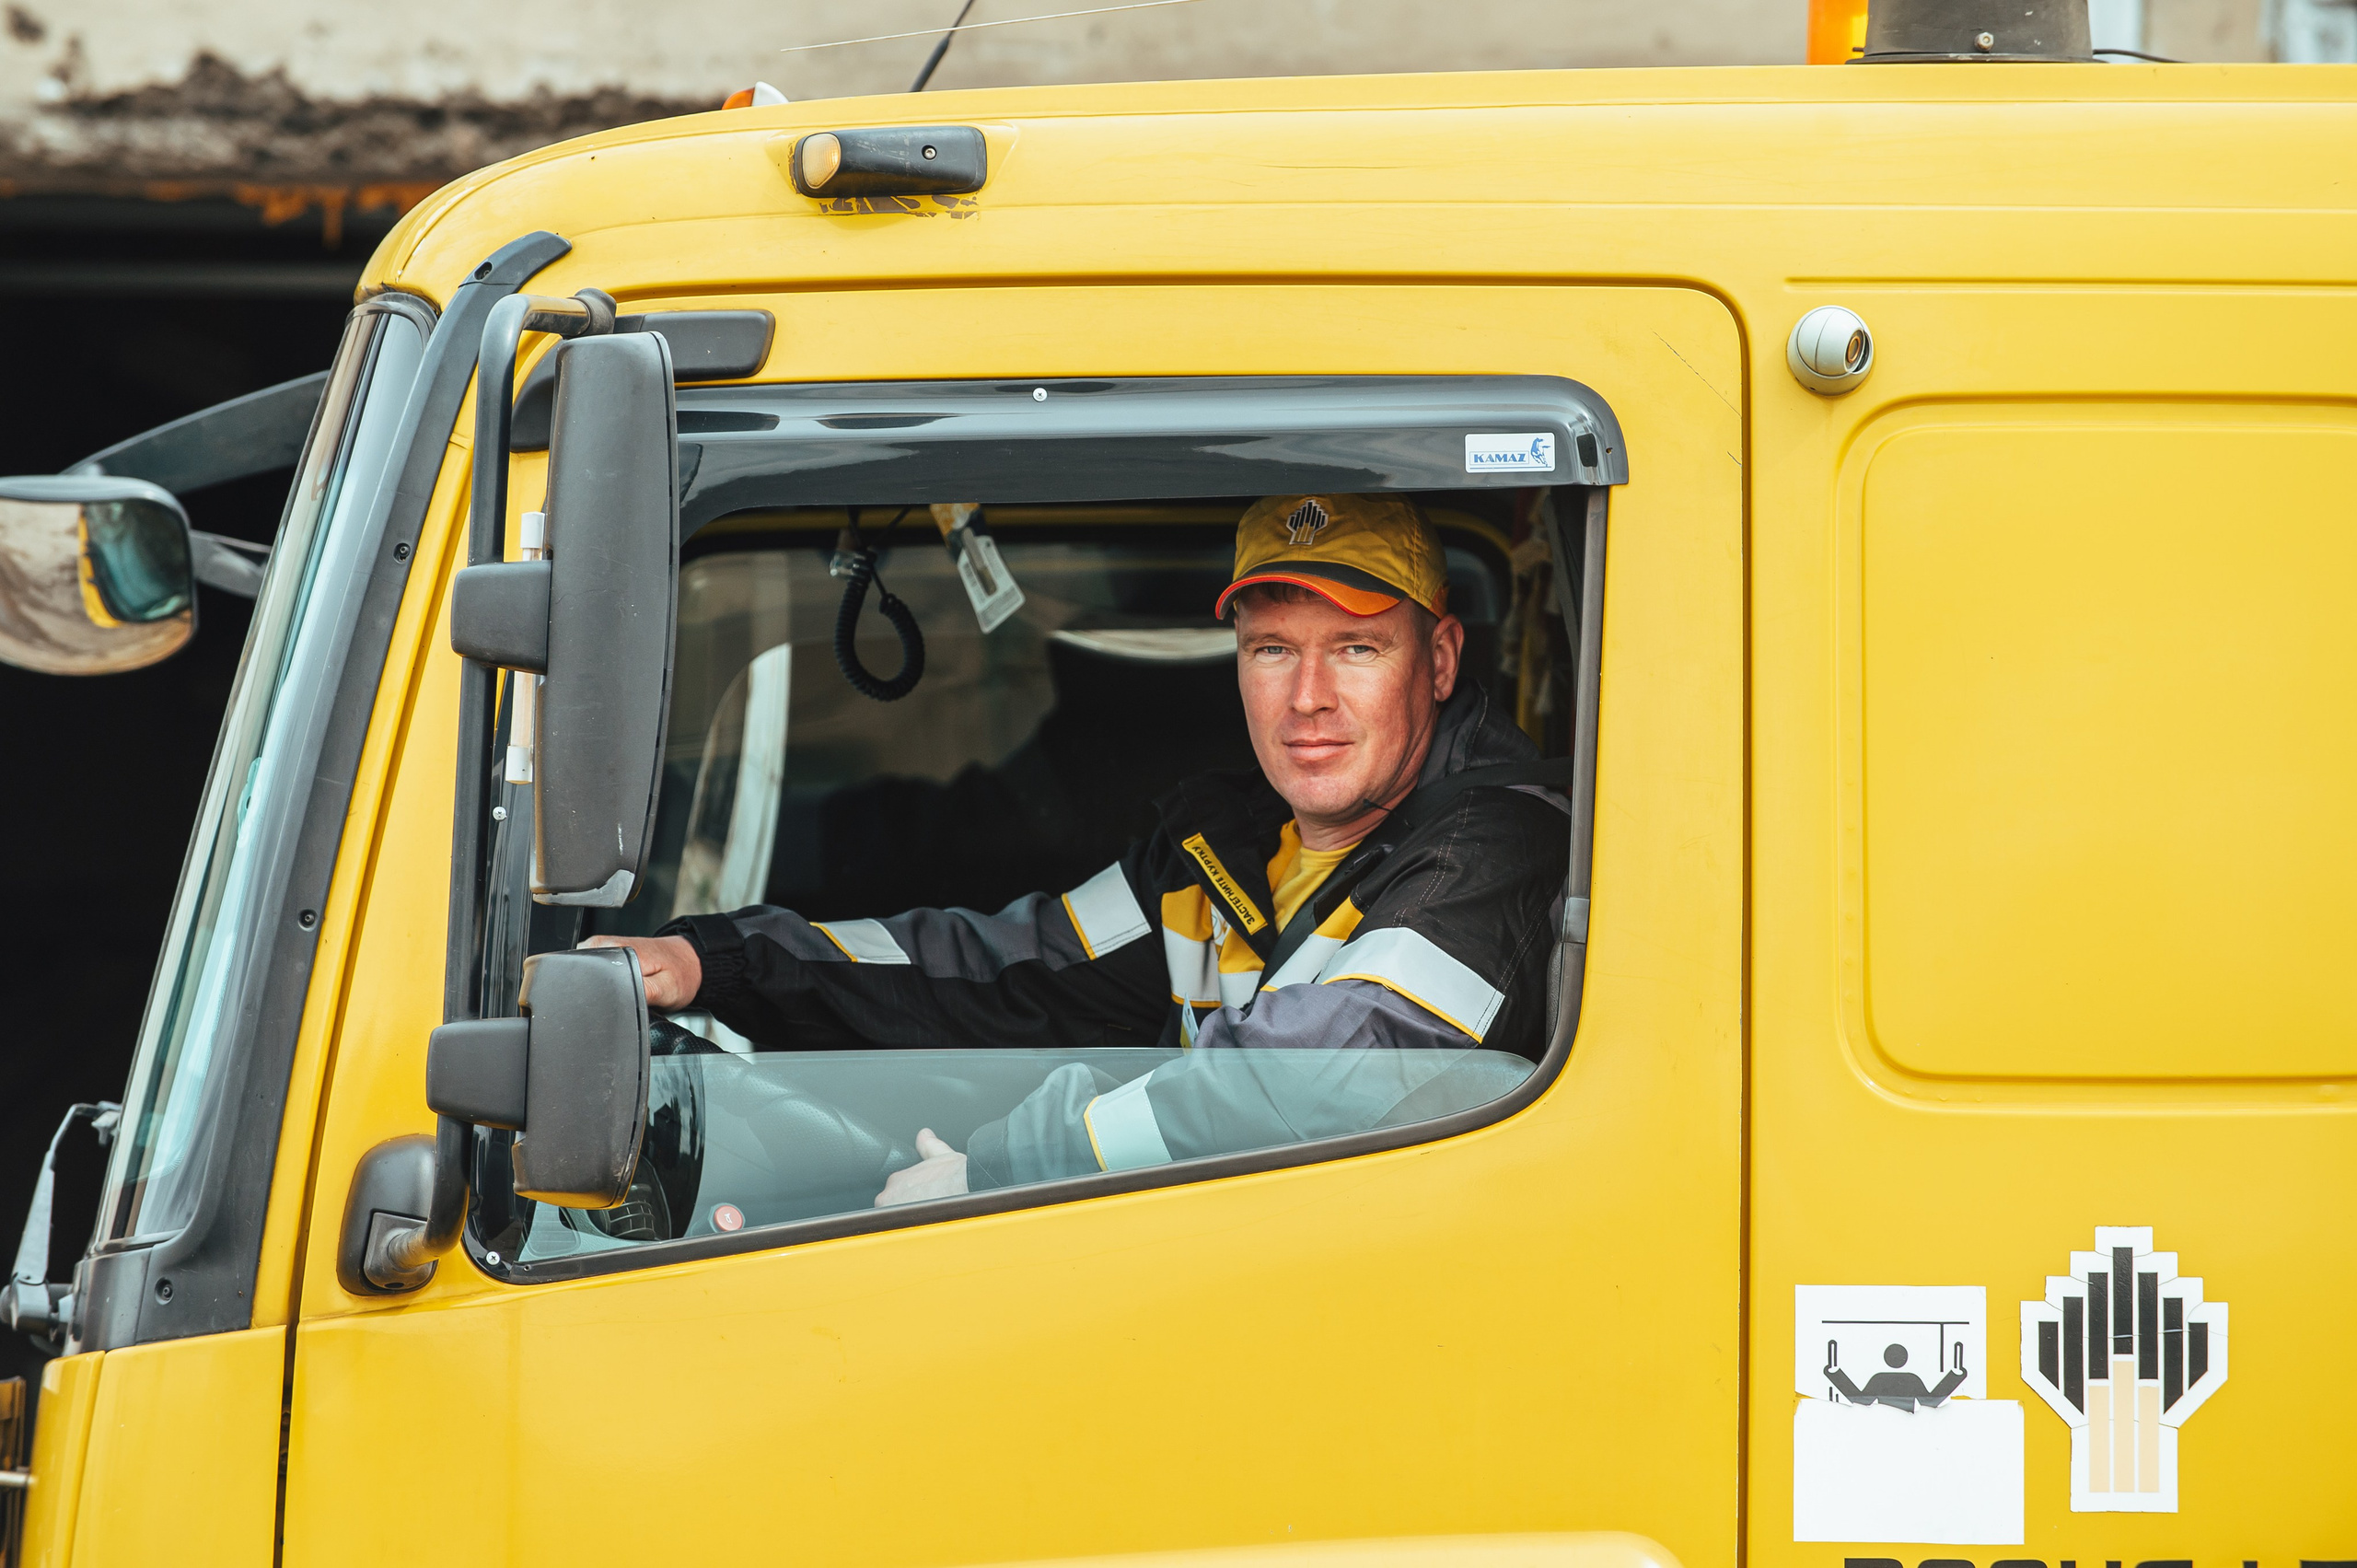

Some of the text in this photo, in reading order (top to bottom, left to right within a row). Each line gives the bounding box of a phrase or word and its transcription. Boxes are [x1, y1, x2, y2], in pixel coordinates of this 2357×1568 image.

[1474, 453, 1526, 462] KAMAZ
[1191, 846, 1255, 925] ЗАСТЕГНИТЕ КУРТКУ
